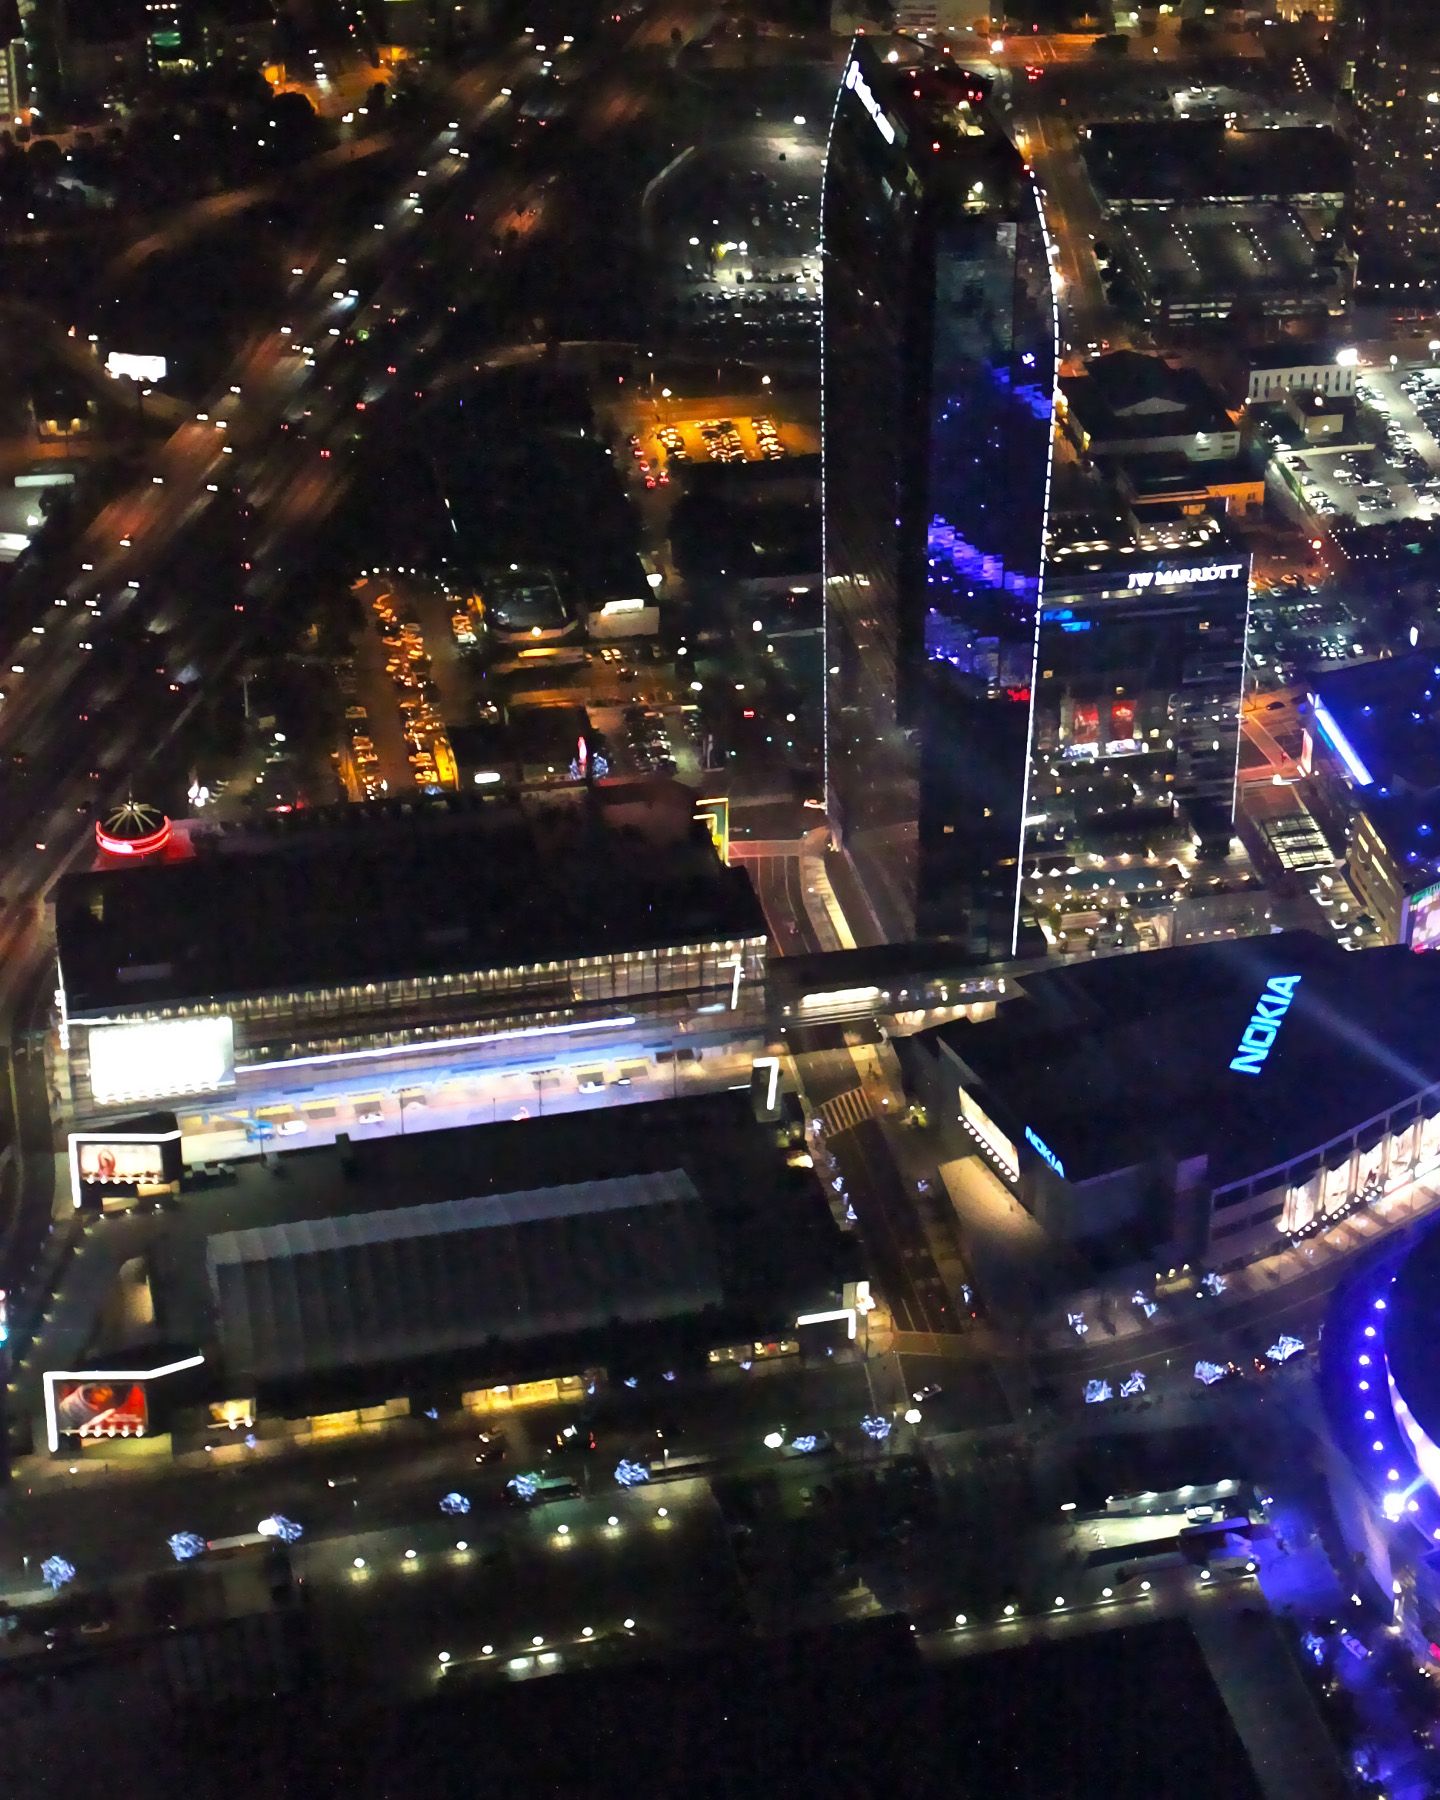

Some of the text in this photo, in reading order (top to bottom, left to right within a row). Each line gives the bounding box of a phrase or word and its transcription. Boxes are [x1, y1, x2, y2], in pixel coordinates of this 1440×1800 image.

[1127, 564, 1242, 590] JW MARRIOTT
[1229, 975, 1301, 1074] NOKIA
[1025, 1125, 1065, 1179] NOKIA
